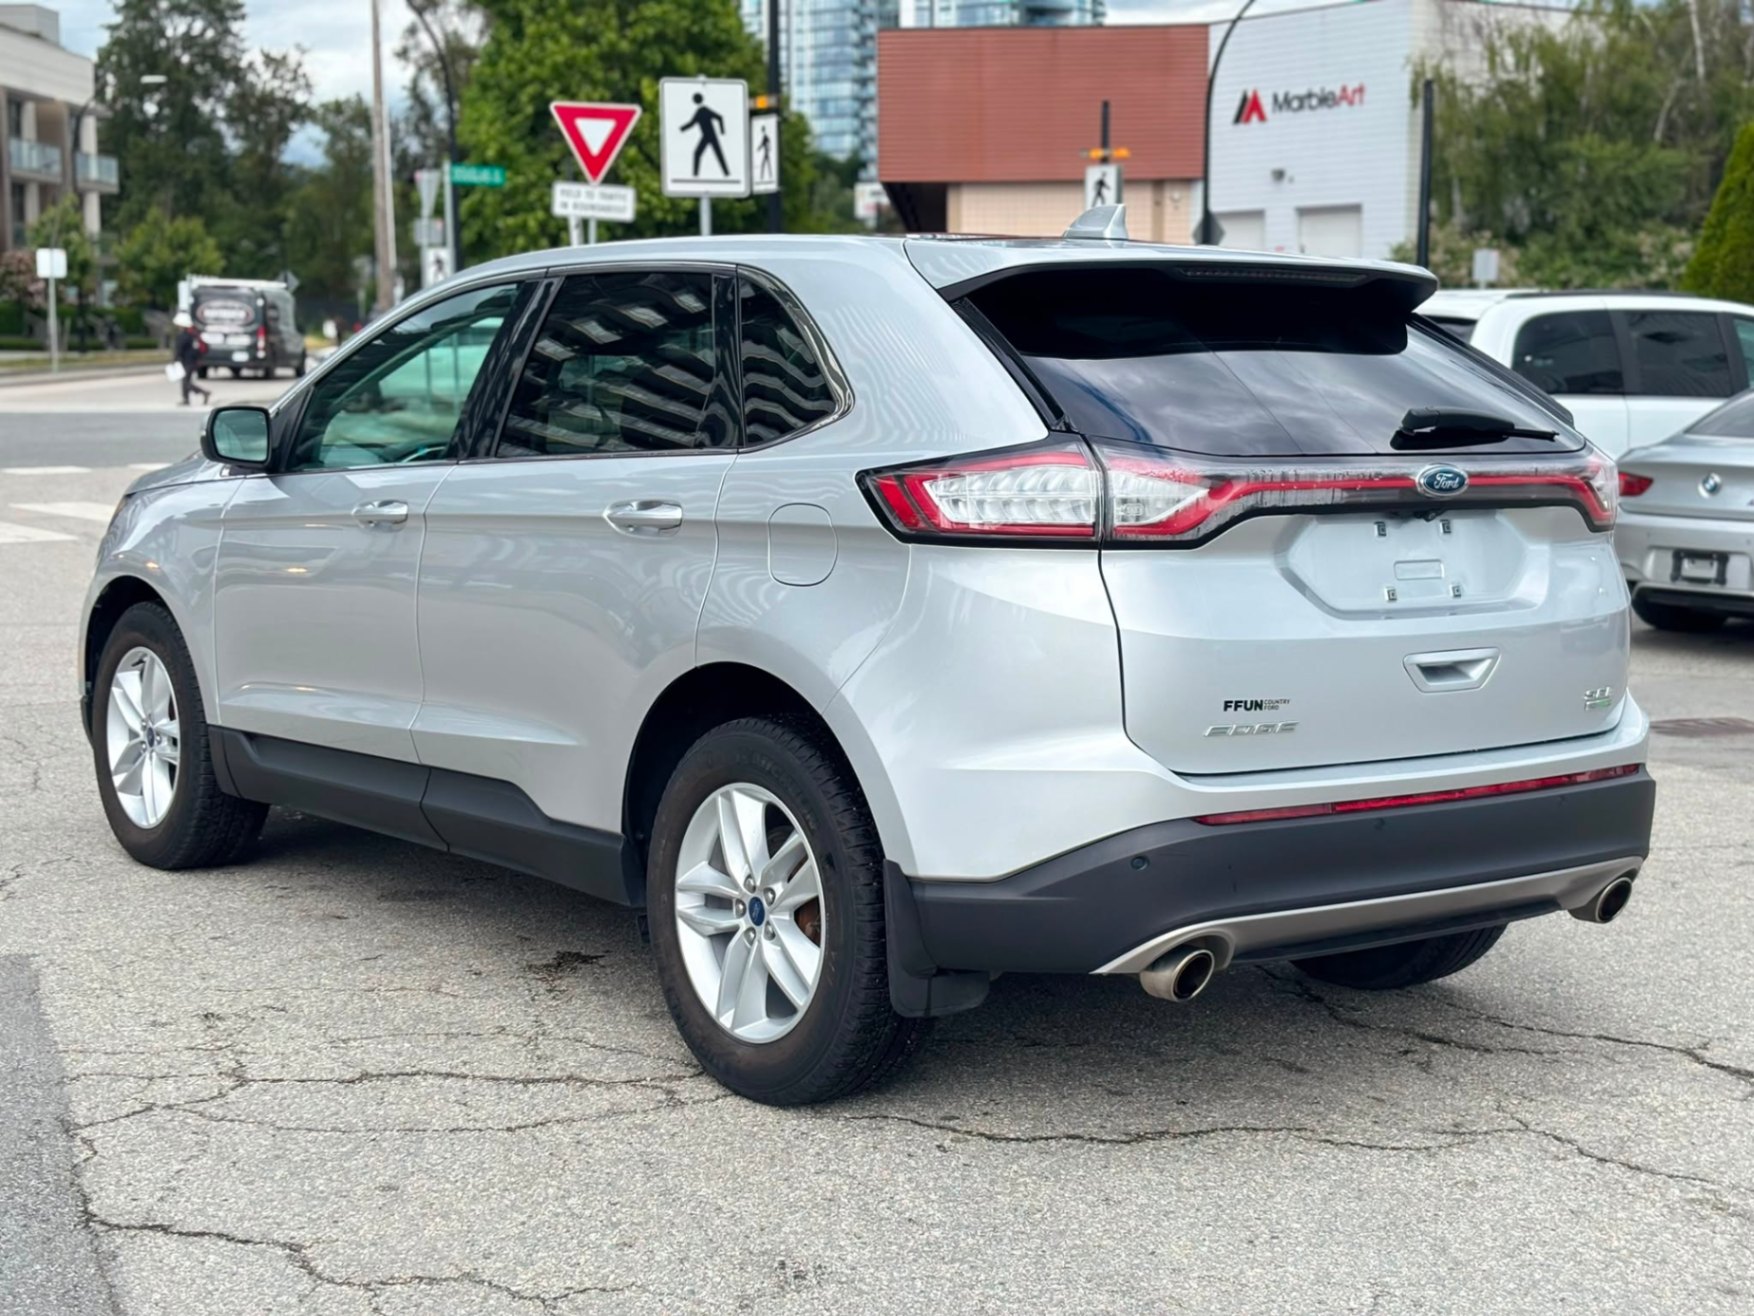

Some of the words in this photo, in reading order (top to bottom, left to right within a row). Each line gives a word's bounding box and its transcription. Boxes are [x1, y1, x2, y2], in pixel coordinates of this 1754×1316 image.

[1273, 83, 1366, 112] MarbleArt
[1433, 472, 1460, 489] Ford
[1223, 699, 1264, 712] FFUN
[1204, 720, 1299, 736] EDGE
